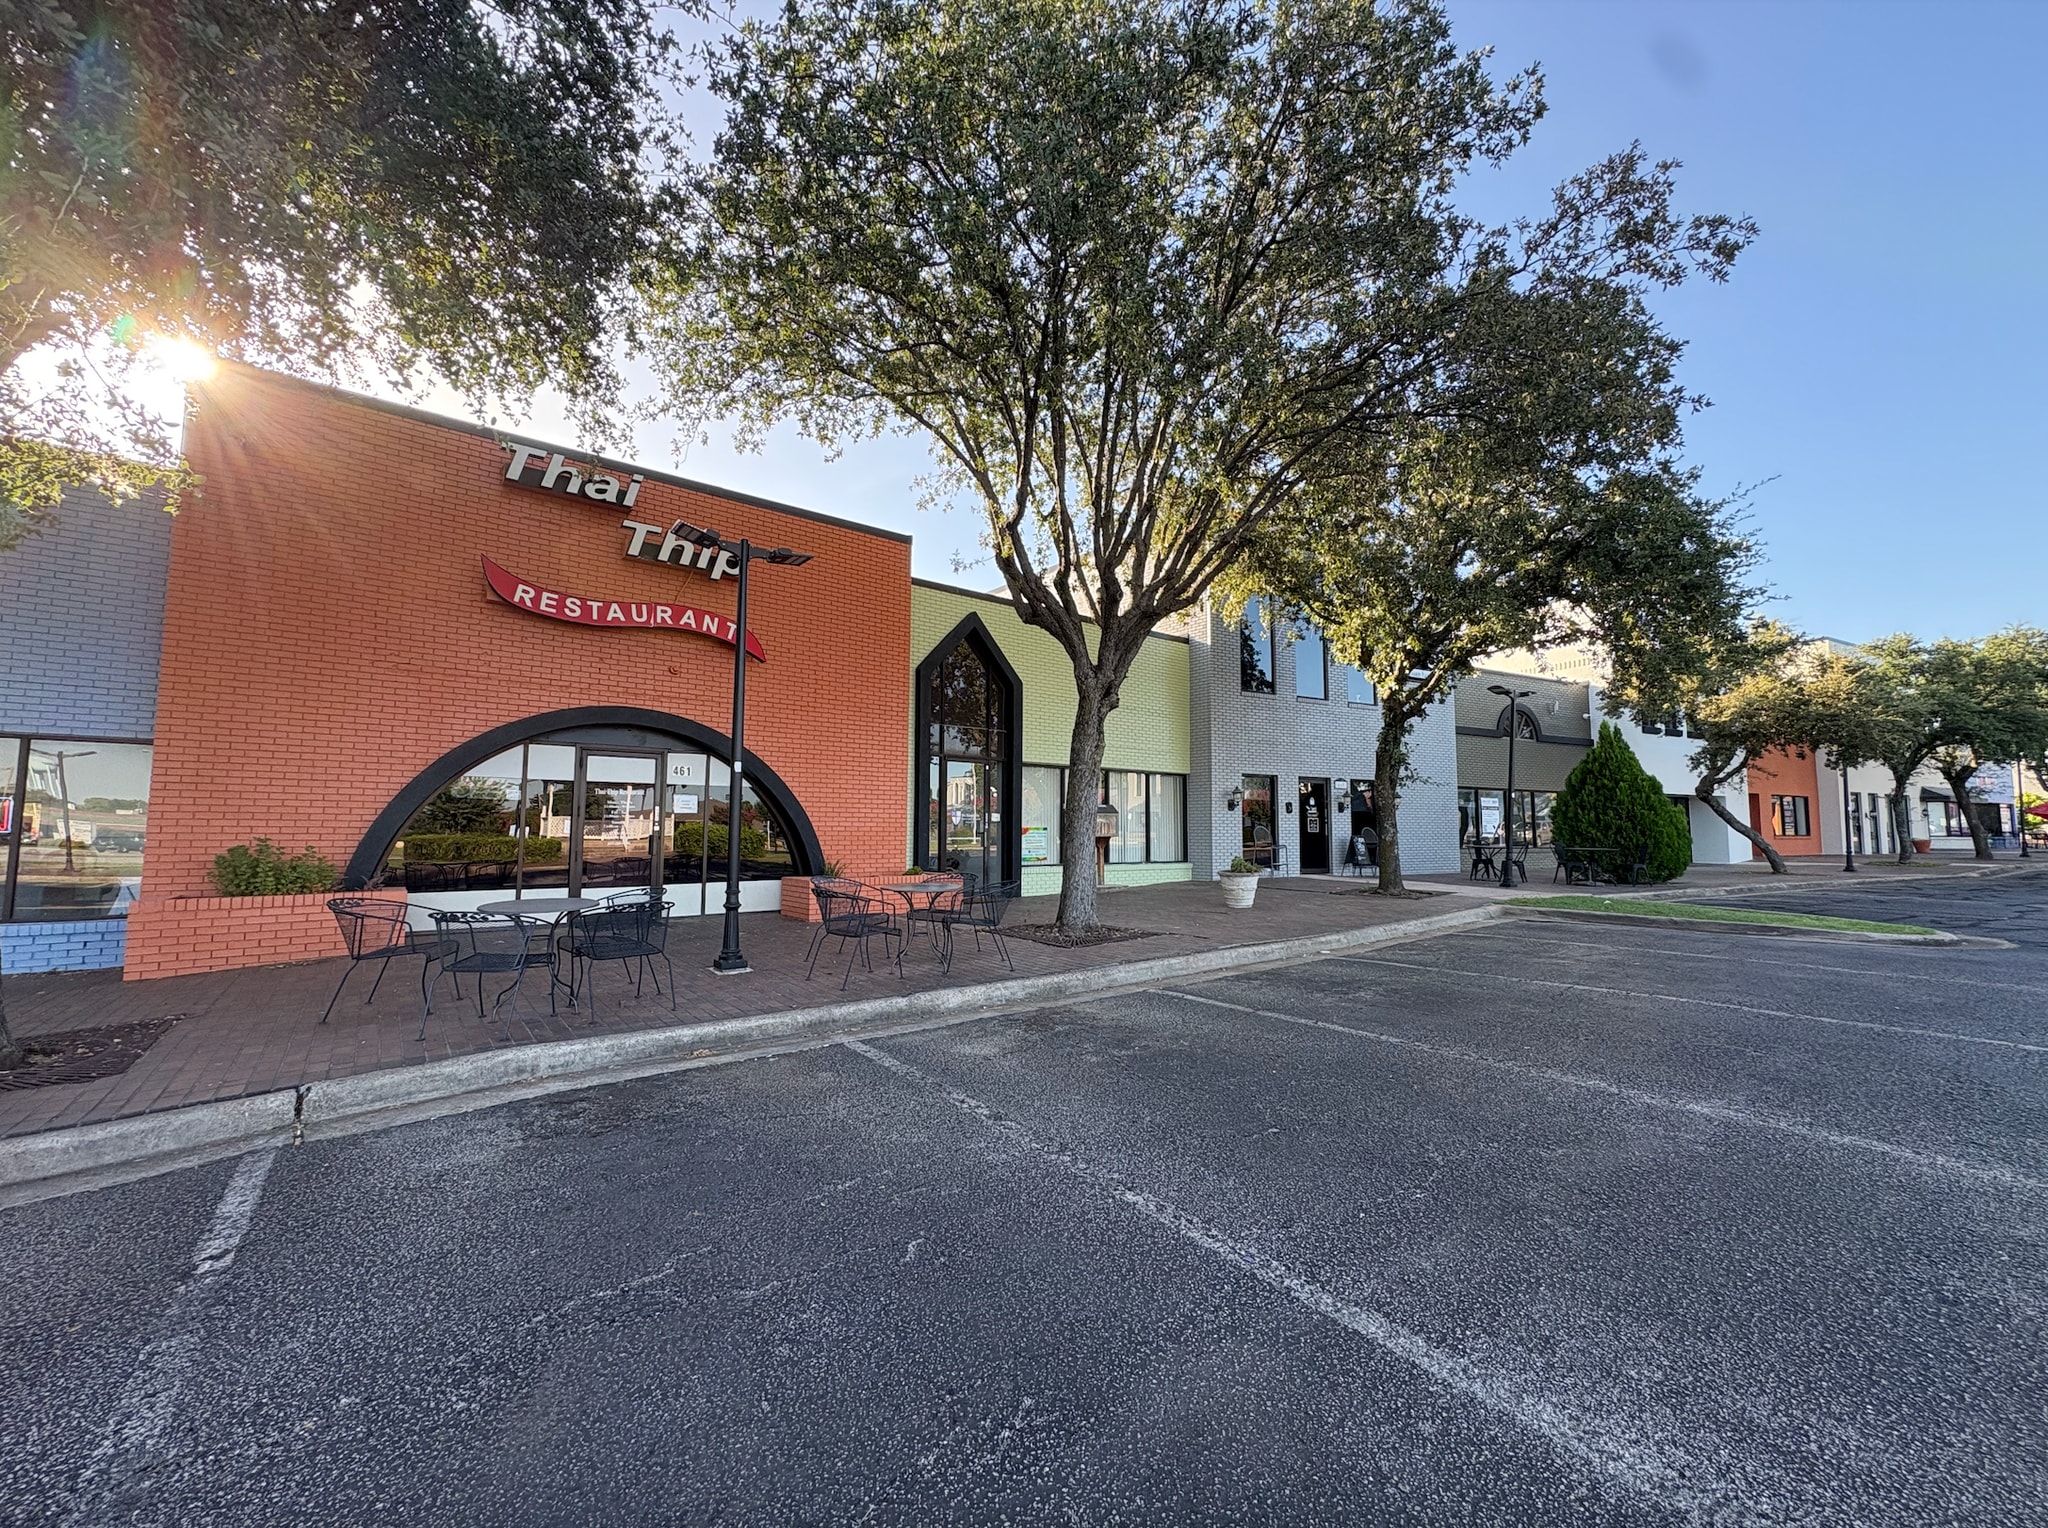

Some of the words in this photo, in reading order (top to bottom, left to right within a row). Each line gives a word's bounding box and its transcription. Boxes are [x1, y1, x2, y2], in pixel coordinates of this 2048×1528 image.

[504, 444, 644, 507] Thai
[622, 521, 741, 580] Thip
[514, 584, 738, 640] RESTAURANT
[673, 766, 691, 776] 461
